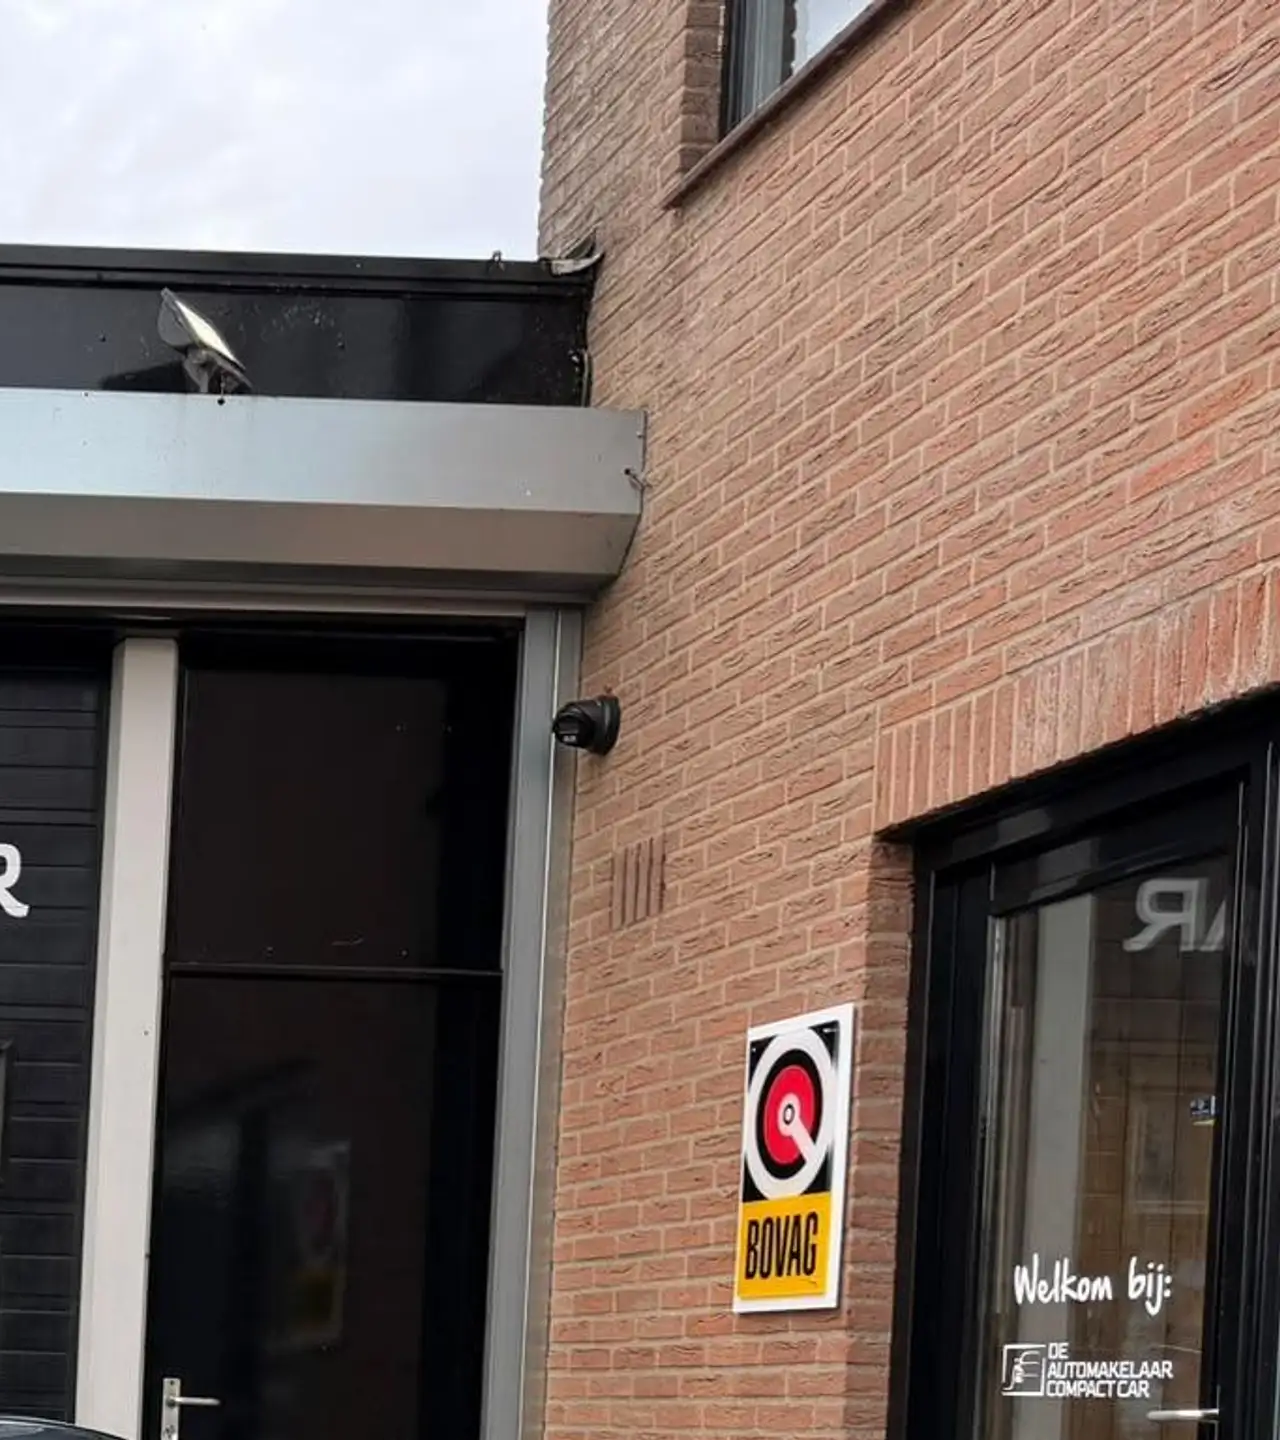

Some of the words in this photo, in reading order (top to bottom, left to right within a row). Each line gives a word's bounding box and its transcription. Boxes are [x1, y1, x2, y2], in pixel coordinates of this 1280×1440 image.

[744, 1211, 818, 1280] BOVAG
[1014, 1253, 1113, 1305] Welkom
[1128, 1256, 1172, 1316] bij:
[1048, 1342, 1069, 1359] DE
[1047, 1361, 1174, 1379] AUTOMAKELAAR
[1046, 1380, 1115, 1398] COMPACT
[1117, 1380, 1150, 1398] CAR
